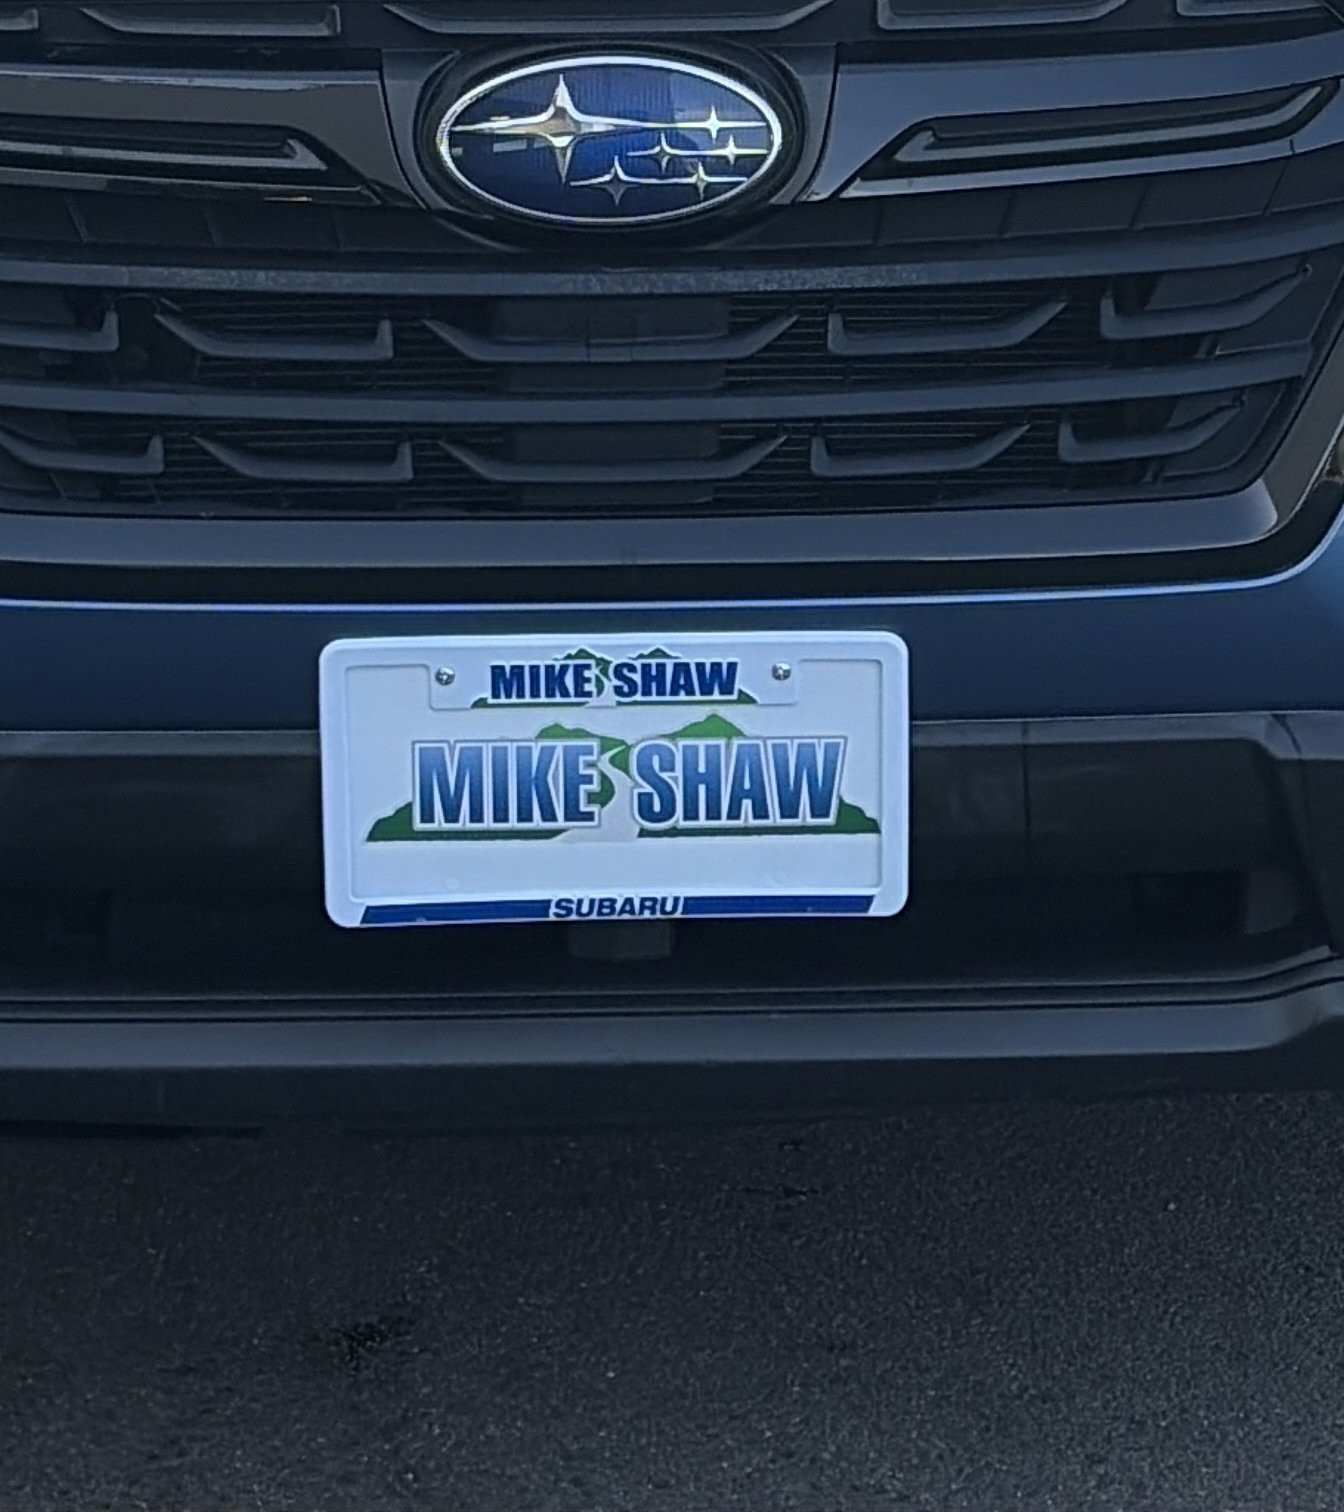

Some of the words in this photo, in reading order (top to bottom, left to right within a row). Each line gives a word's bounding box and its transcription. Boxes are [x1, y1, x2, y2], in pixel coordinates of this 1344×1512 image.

[489, 661, 594, 701] MIKE
[613, 660, 738, 699] SHAW
[416, 742, 599, 826] MIKE
[632, 739, 844, 825] SHAW
[552, 896, 682, 919] SUBARU
